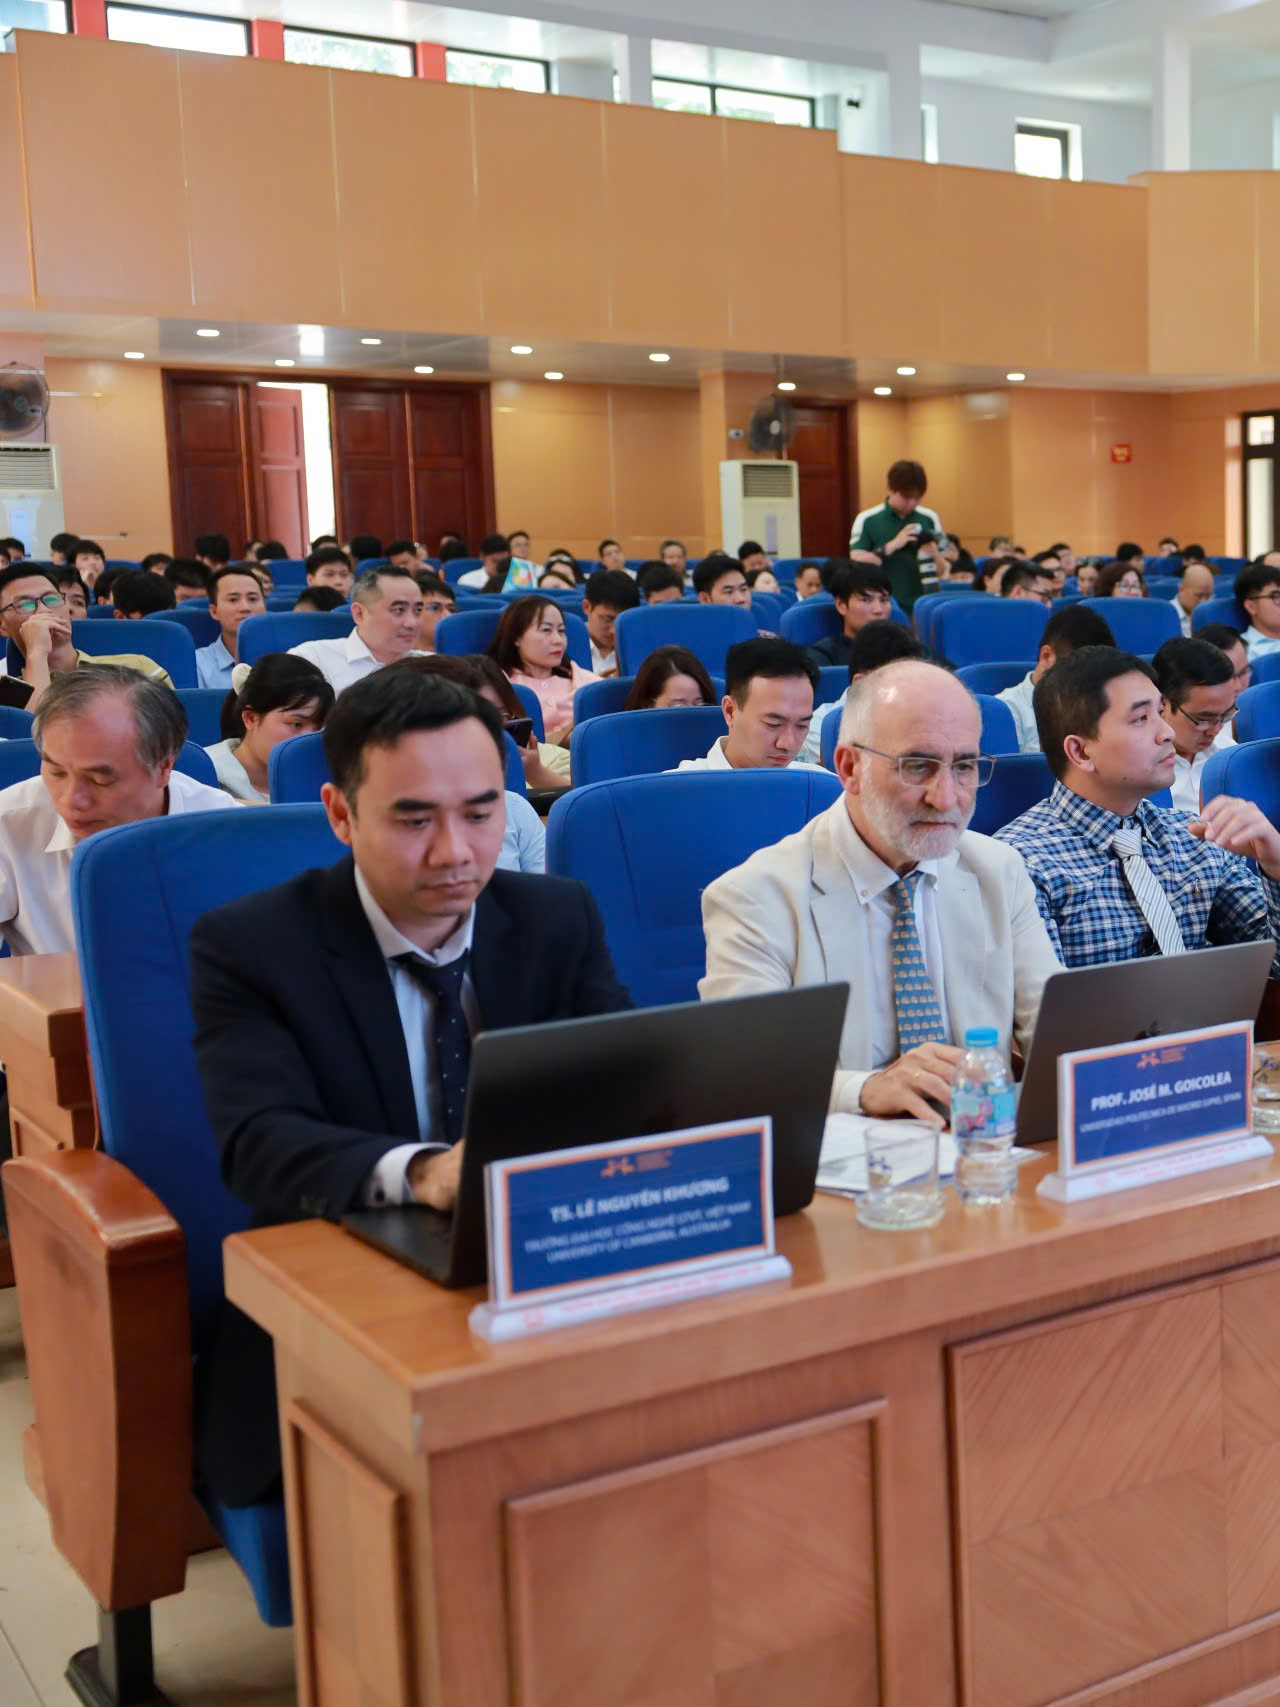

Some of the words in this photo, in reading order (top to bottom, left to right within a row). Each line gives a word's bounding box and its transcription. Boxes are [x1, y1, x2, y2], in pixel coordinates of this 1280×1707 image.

[1090, 1091, 1127, 1112] PROF.
[1128, 1083, 1157, 1104] JOSÉ
[1158, 1082, 1173, 1098] M.
[1174, 1070, 1232, 1095] GOICOLEA
